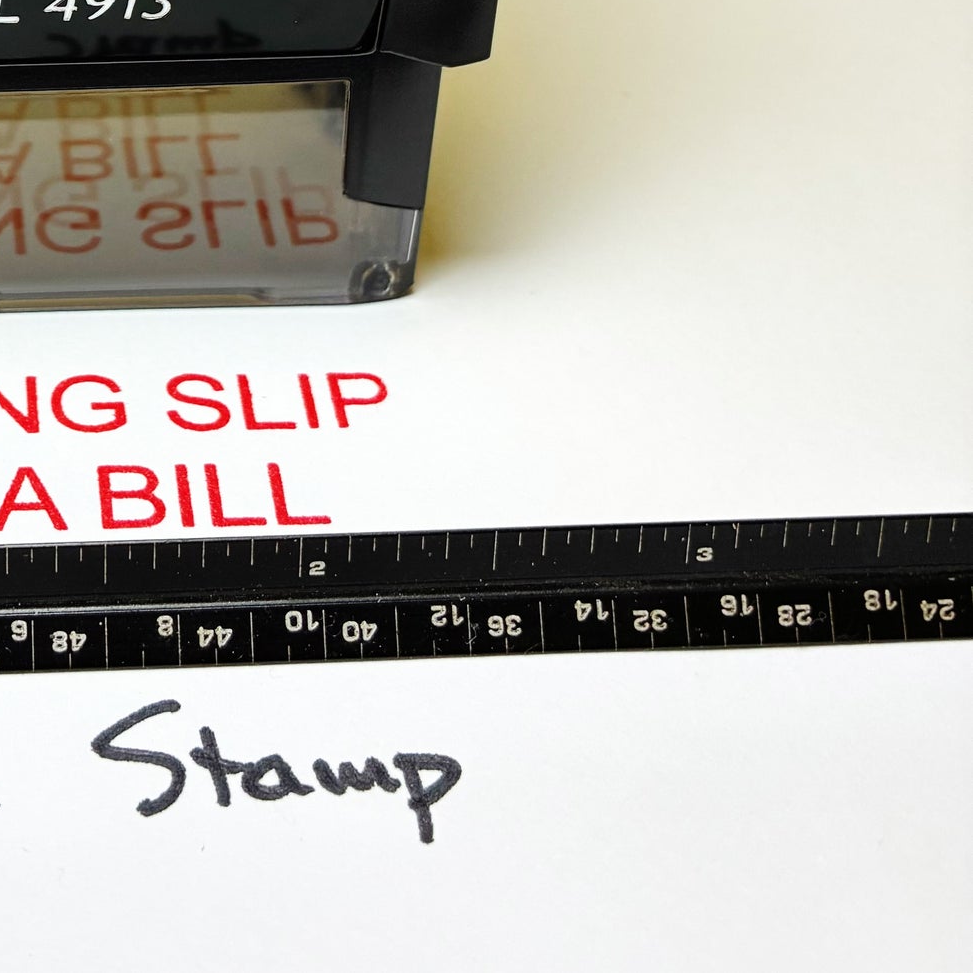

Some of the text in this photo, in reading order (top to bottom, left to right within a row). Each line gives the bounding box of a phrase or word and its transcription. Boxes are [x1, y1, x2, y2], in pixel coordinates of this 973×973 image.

[166, 372, 387, 433] SLIP
[97, 462, 332, 530] BILL
[309, 560, 326, 576] 2
[696, 546, 714, 562] 3
[575, 599, 609, 622] 14
[721, 593, 754, 617] 16
[864, 589, 898, 611] 18
[921, 598, 955, 622] 24
[156, 614, 174, 637] 8
[285, 609, 320, 633] 10
[431, 604, 465, 627] 12
[488, 614, 522, 637] 36
[633, 609, 668, 632] 32
[777, 604, 813, 627] 28
[50, 630, 87, 653] 48
[197, 625, 233, 648] 44
[342, 620, 378, 643] 40
[91, 700, 463, 845] Stamp
